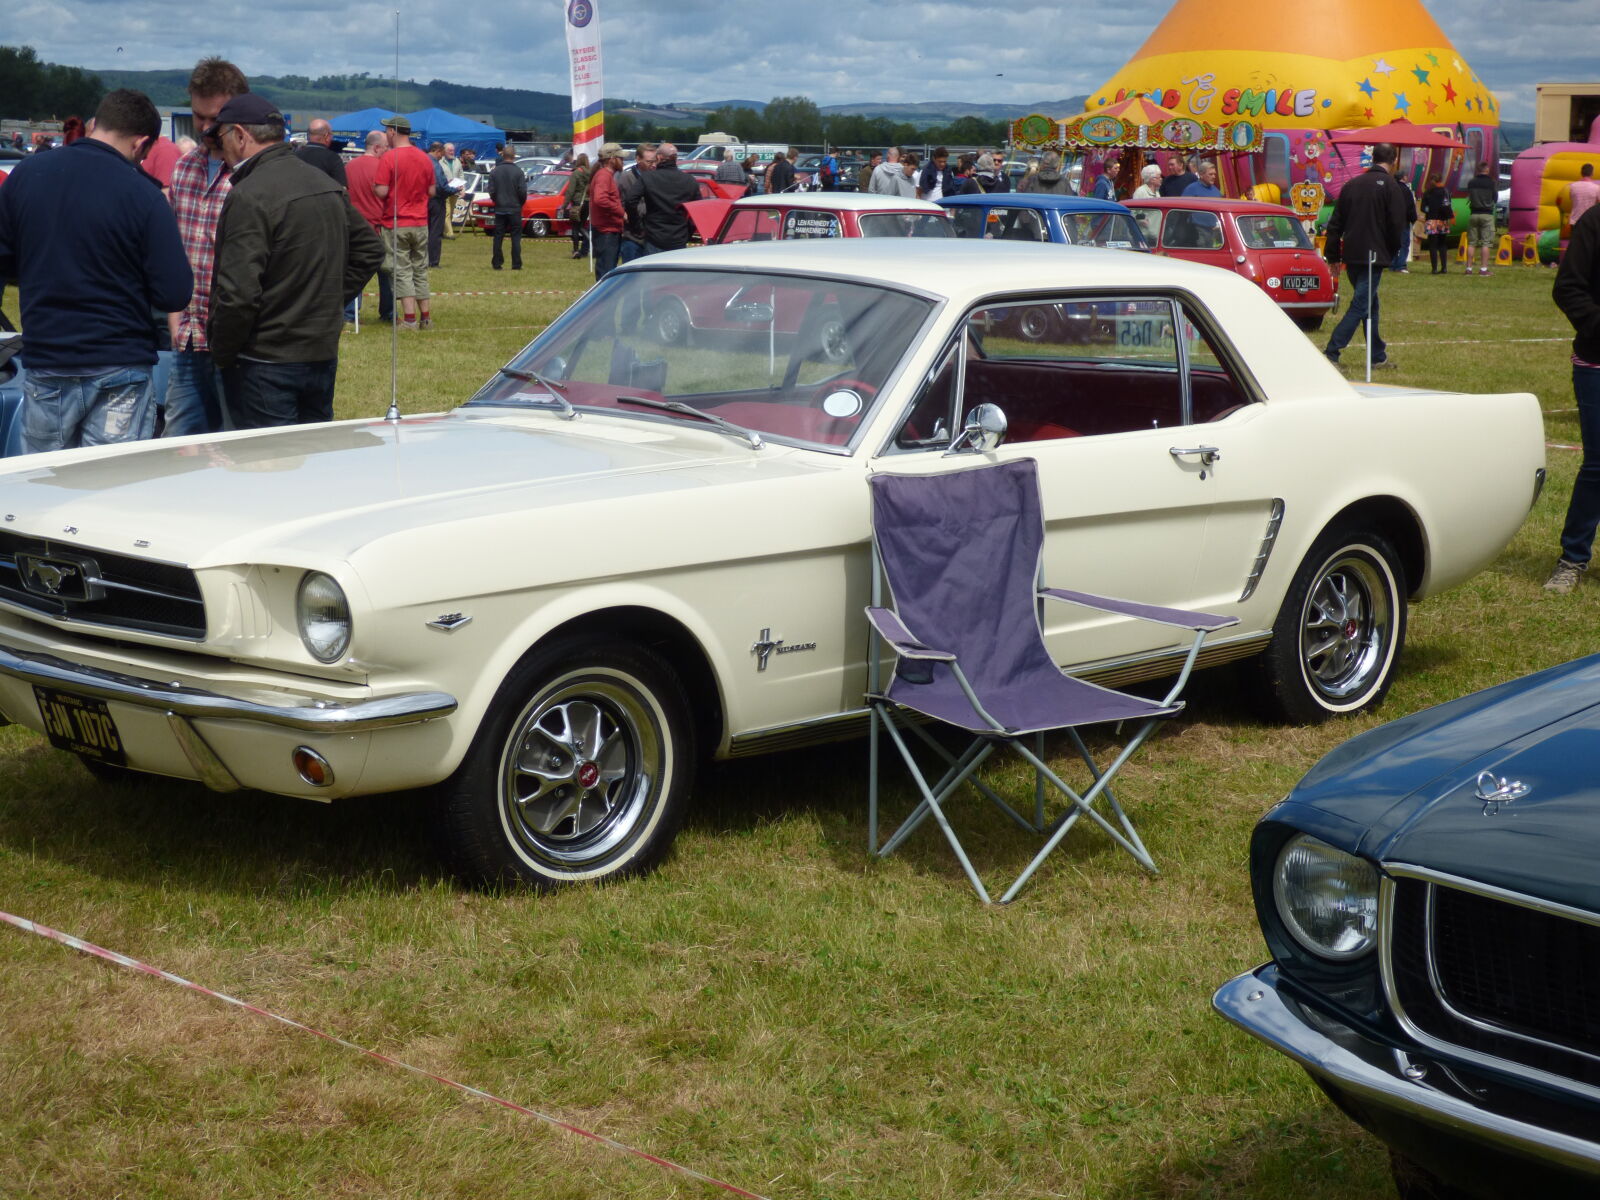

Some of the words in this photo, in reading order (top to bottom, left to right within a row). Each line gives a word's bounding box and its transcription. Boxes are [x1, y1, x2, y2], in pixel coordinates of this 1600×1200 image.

[573, 55, 597, 64] CLASSIC
[1221, 88, 1317, 117] SMILE
[1268, 278, 1279, 286] GB
[1285, 276, 1300, 288] KVD
[1301, 276, 1318, 288] 314L
[39, 698, 76, 740] FJN
[74, 708, 119, 752] 107C
